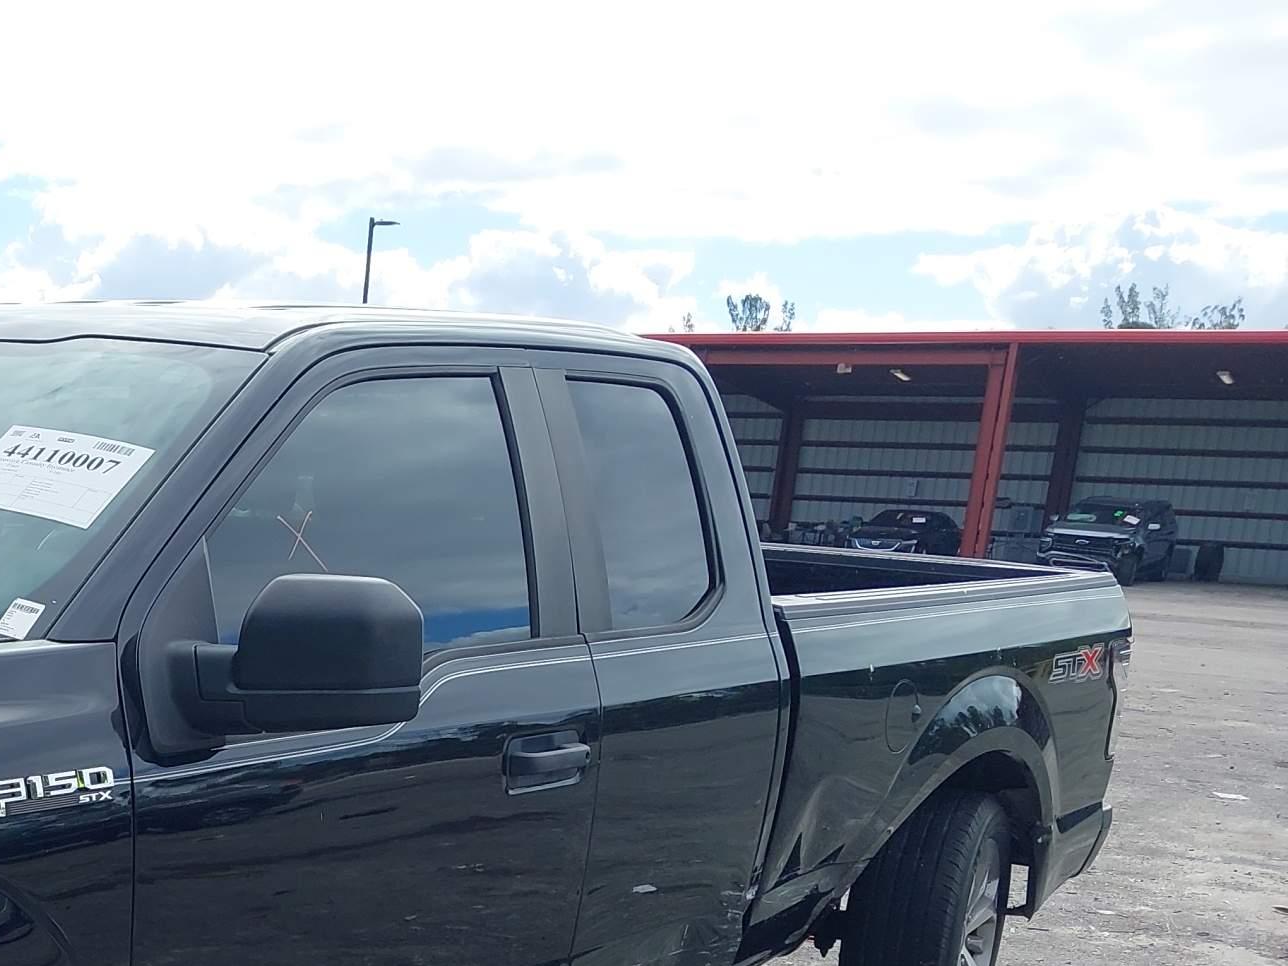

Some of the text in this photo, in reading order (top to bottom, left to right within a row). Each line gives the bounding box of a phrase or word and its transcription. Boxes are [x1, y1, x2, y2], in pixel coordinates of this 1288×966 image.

[3, 443, 122, 475] 44110007
[1048, 643, 1105, 684] STX
[78, 790, 113, 804] STX
